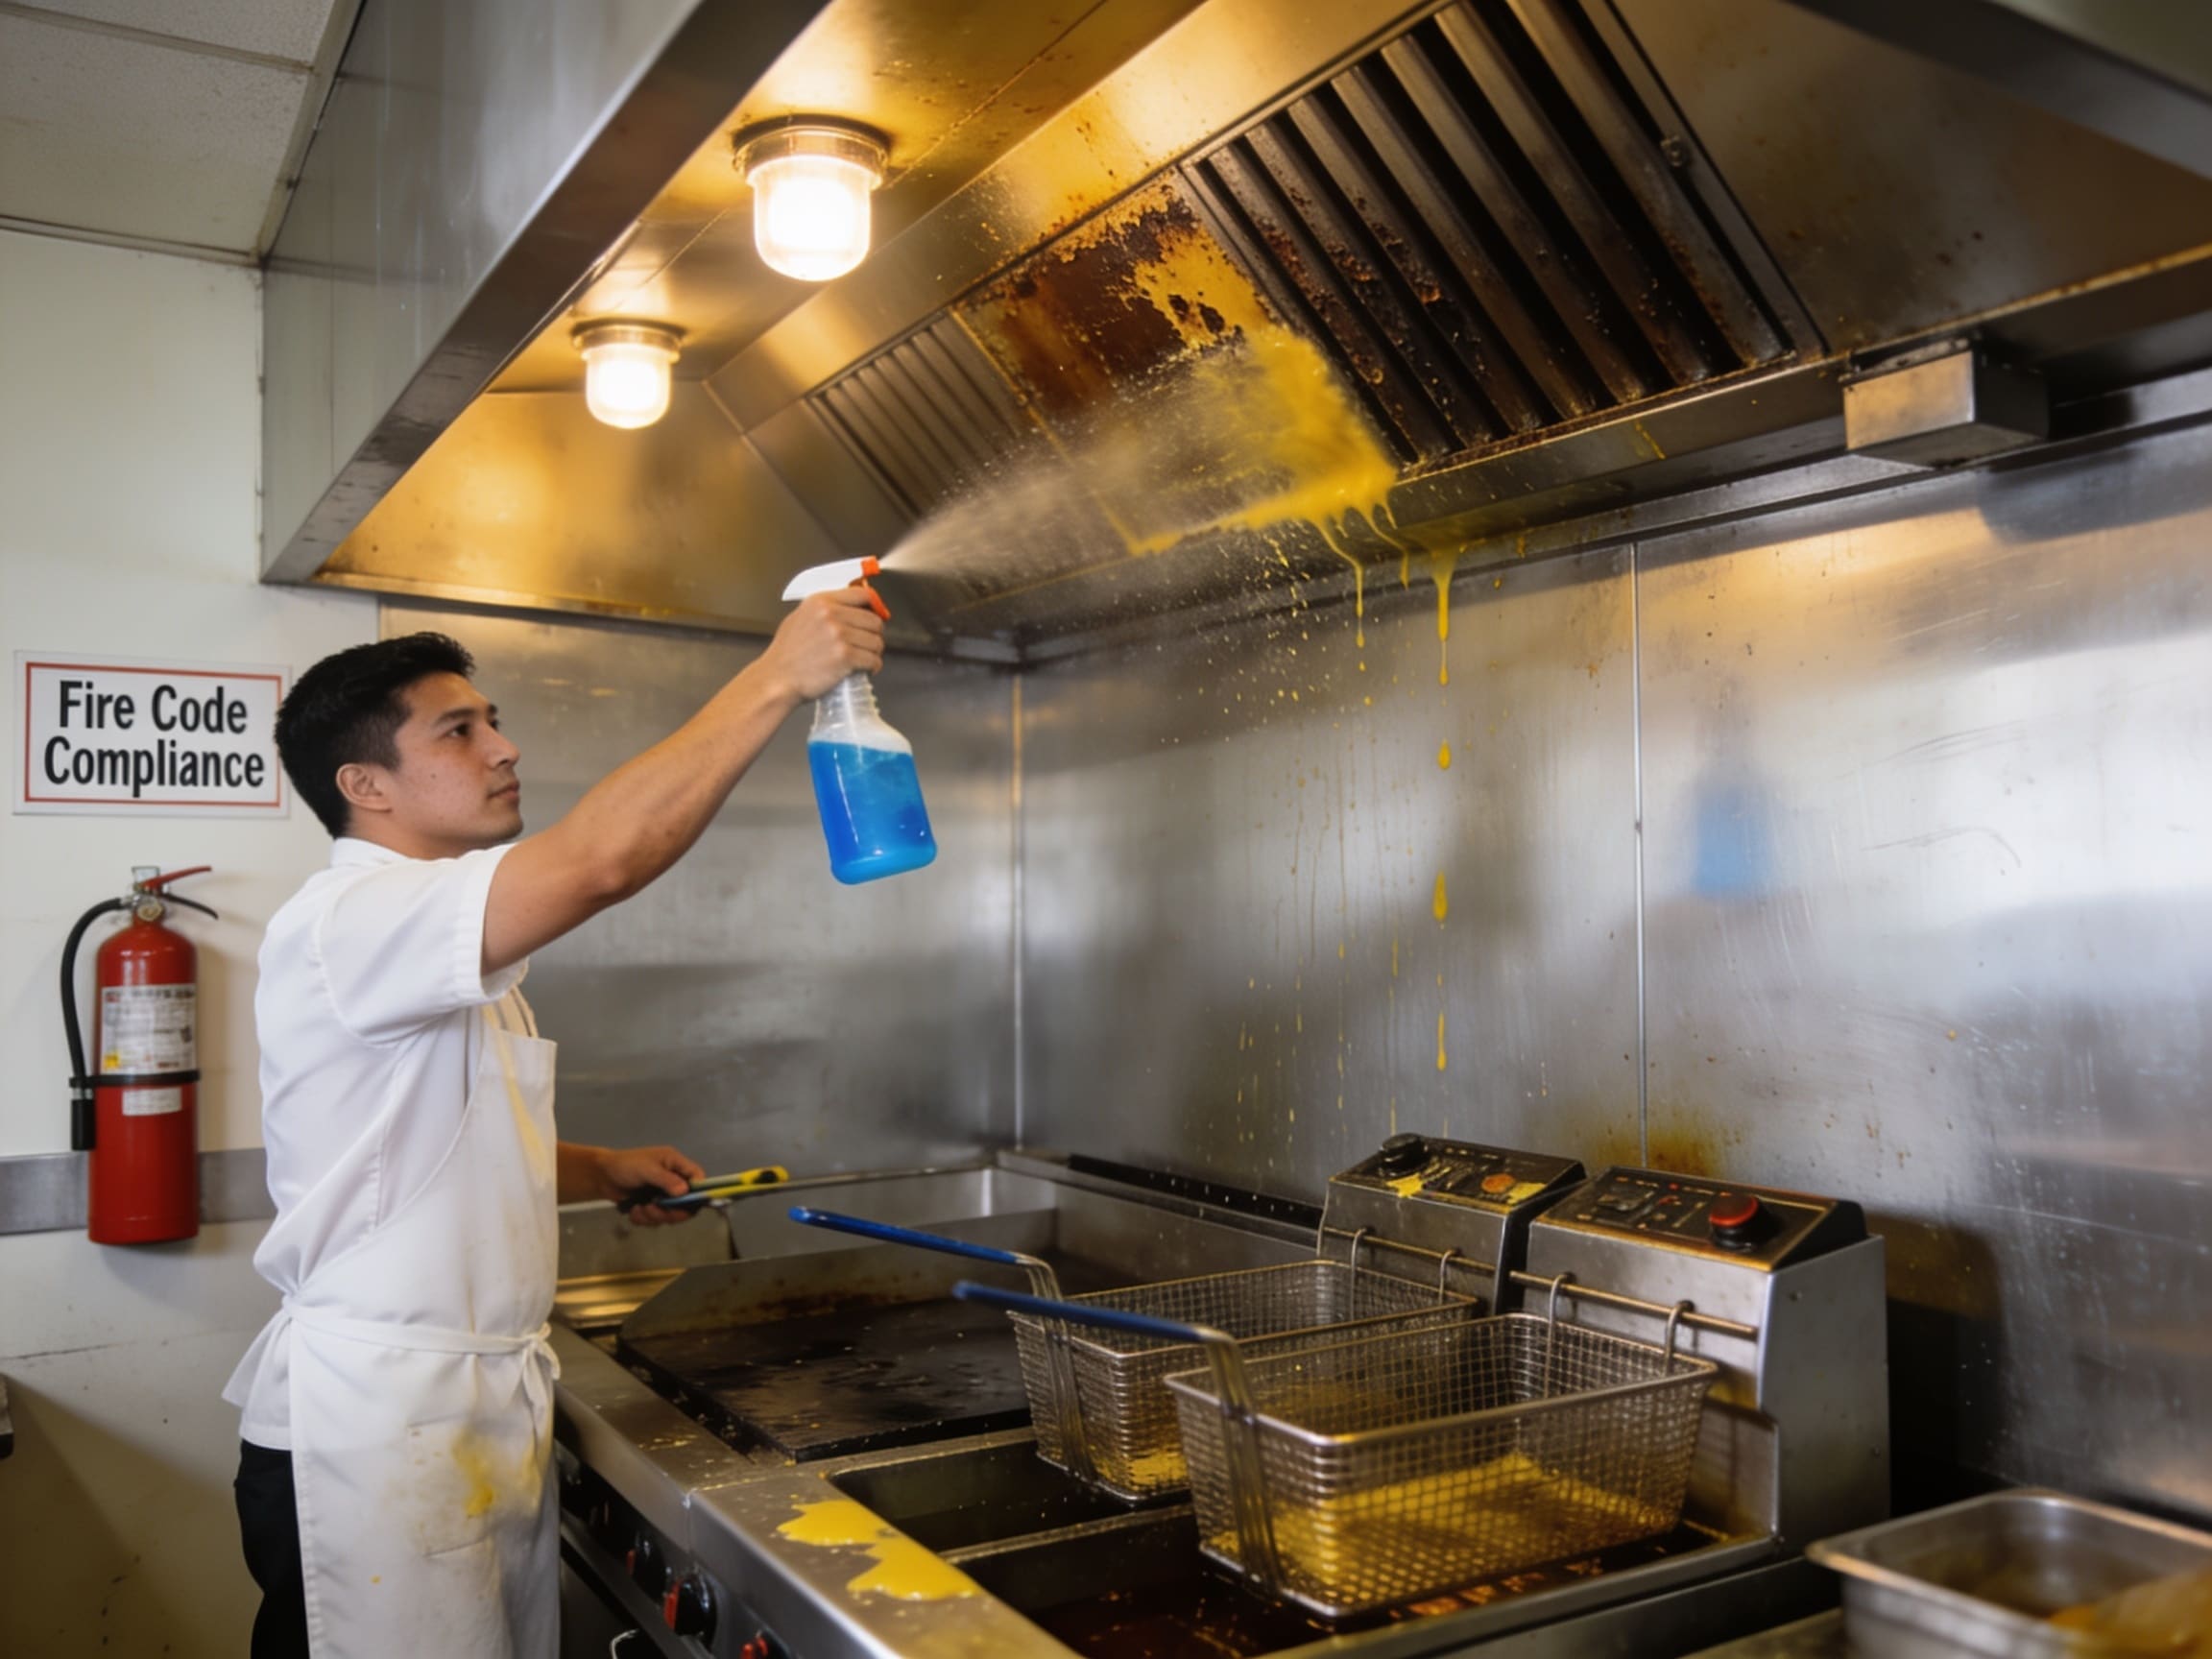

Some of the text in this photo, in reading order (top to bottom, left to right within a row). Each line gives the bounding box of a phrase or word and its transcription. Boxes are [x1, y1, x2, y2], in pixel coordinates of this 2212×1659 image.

[60, 680, 248, 734] Fire Code
[44, 735, 264, 799] Compliance
